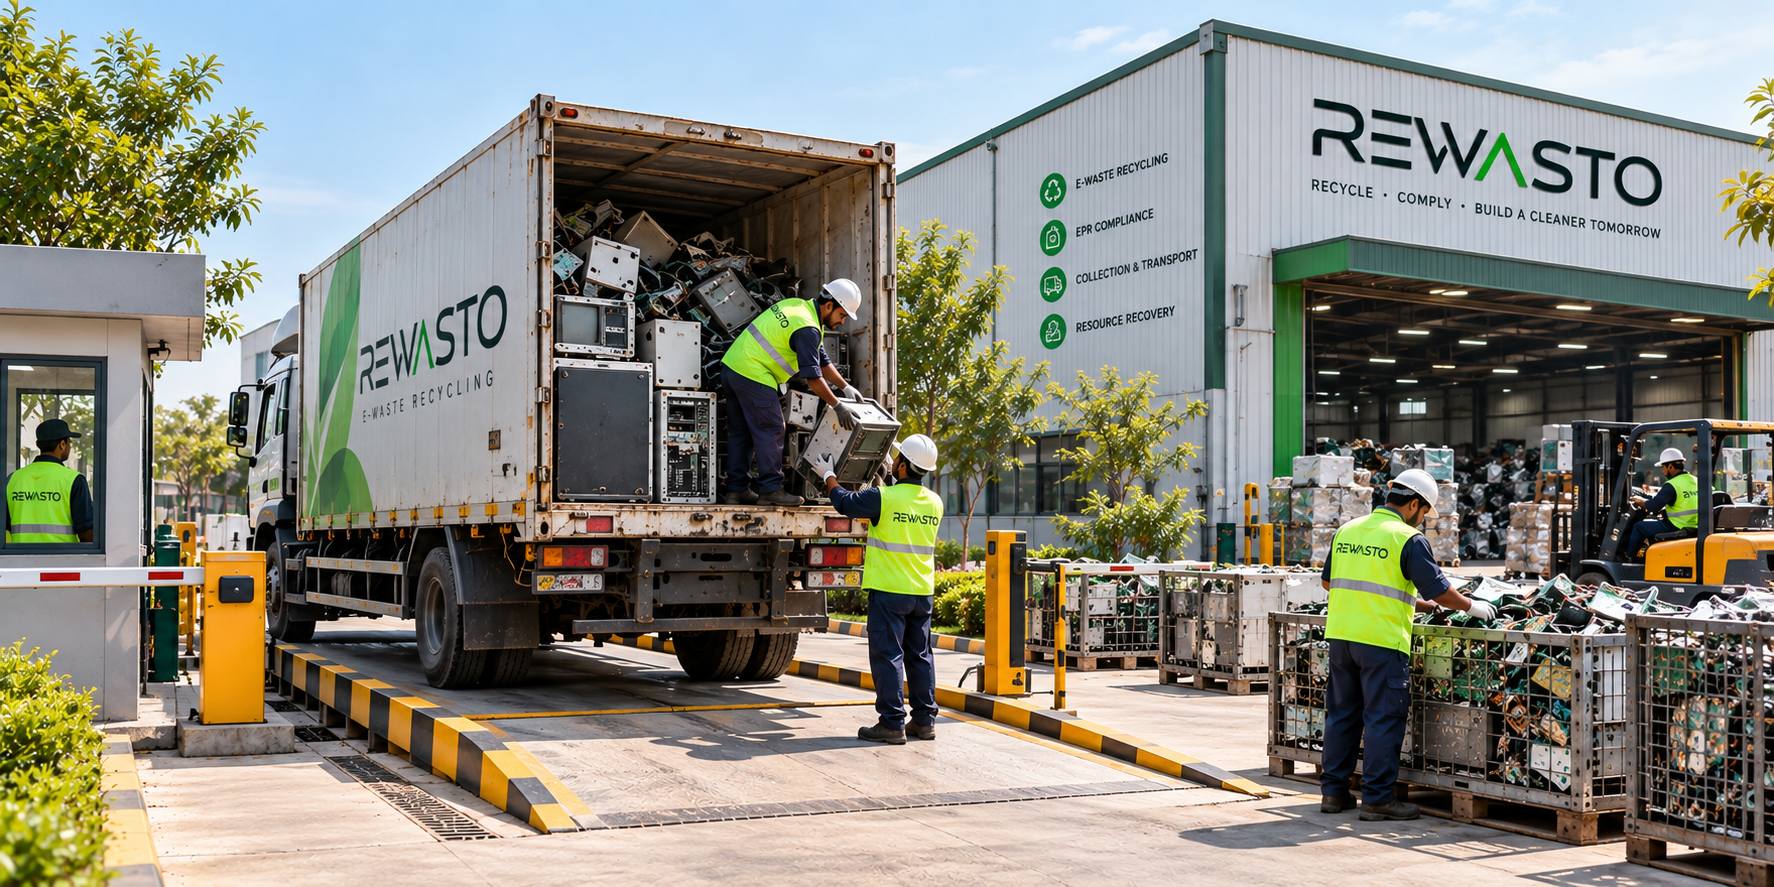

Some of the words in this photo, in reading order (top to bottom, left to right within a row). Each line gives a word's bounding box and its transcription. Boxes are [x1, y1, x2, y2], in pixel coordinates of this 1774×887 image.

[1075, 168, 1115, 190] E-WASTE
[1116, 152, 1169, 178] RECYCLING
[1312, 98, 1663, 207] REWASTO
[1075, 223, 1093, 238] EPR
[1094, 208, 1154, 233] COMPLIANCE
[1311, 178, 1374, 199] RECYCLE
[1397, 191, 1452, 210] COMPLY
[1475, 202, 1513, 219] BUILD
[1517, 209, 1526, 221] A
[1530, 210, 1586, 229] CLEANER
[1590, 219, 1662, 239] TOMORROW
[1075, 263, 1131, 285] COLLECTION
[1132, 261, 1140, 273] &
[1141, 248, 1199, 270] TRANSPORT
[1075, 314, 1124, 333] RESOURCE
[1125, 305, 1176, 325] RECOVERY
[359, 284, 508, 395] REWASTO
[362, 398, 405, 424] E-WASTE
[412, 369, 494, 409] RECYCLING
[12, 491, 62, 502] REWASTO
[893, 511, 939, 526] REWASTO
[1335, 542, 1389, 560] REWASTO
